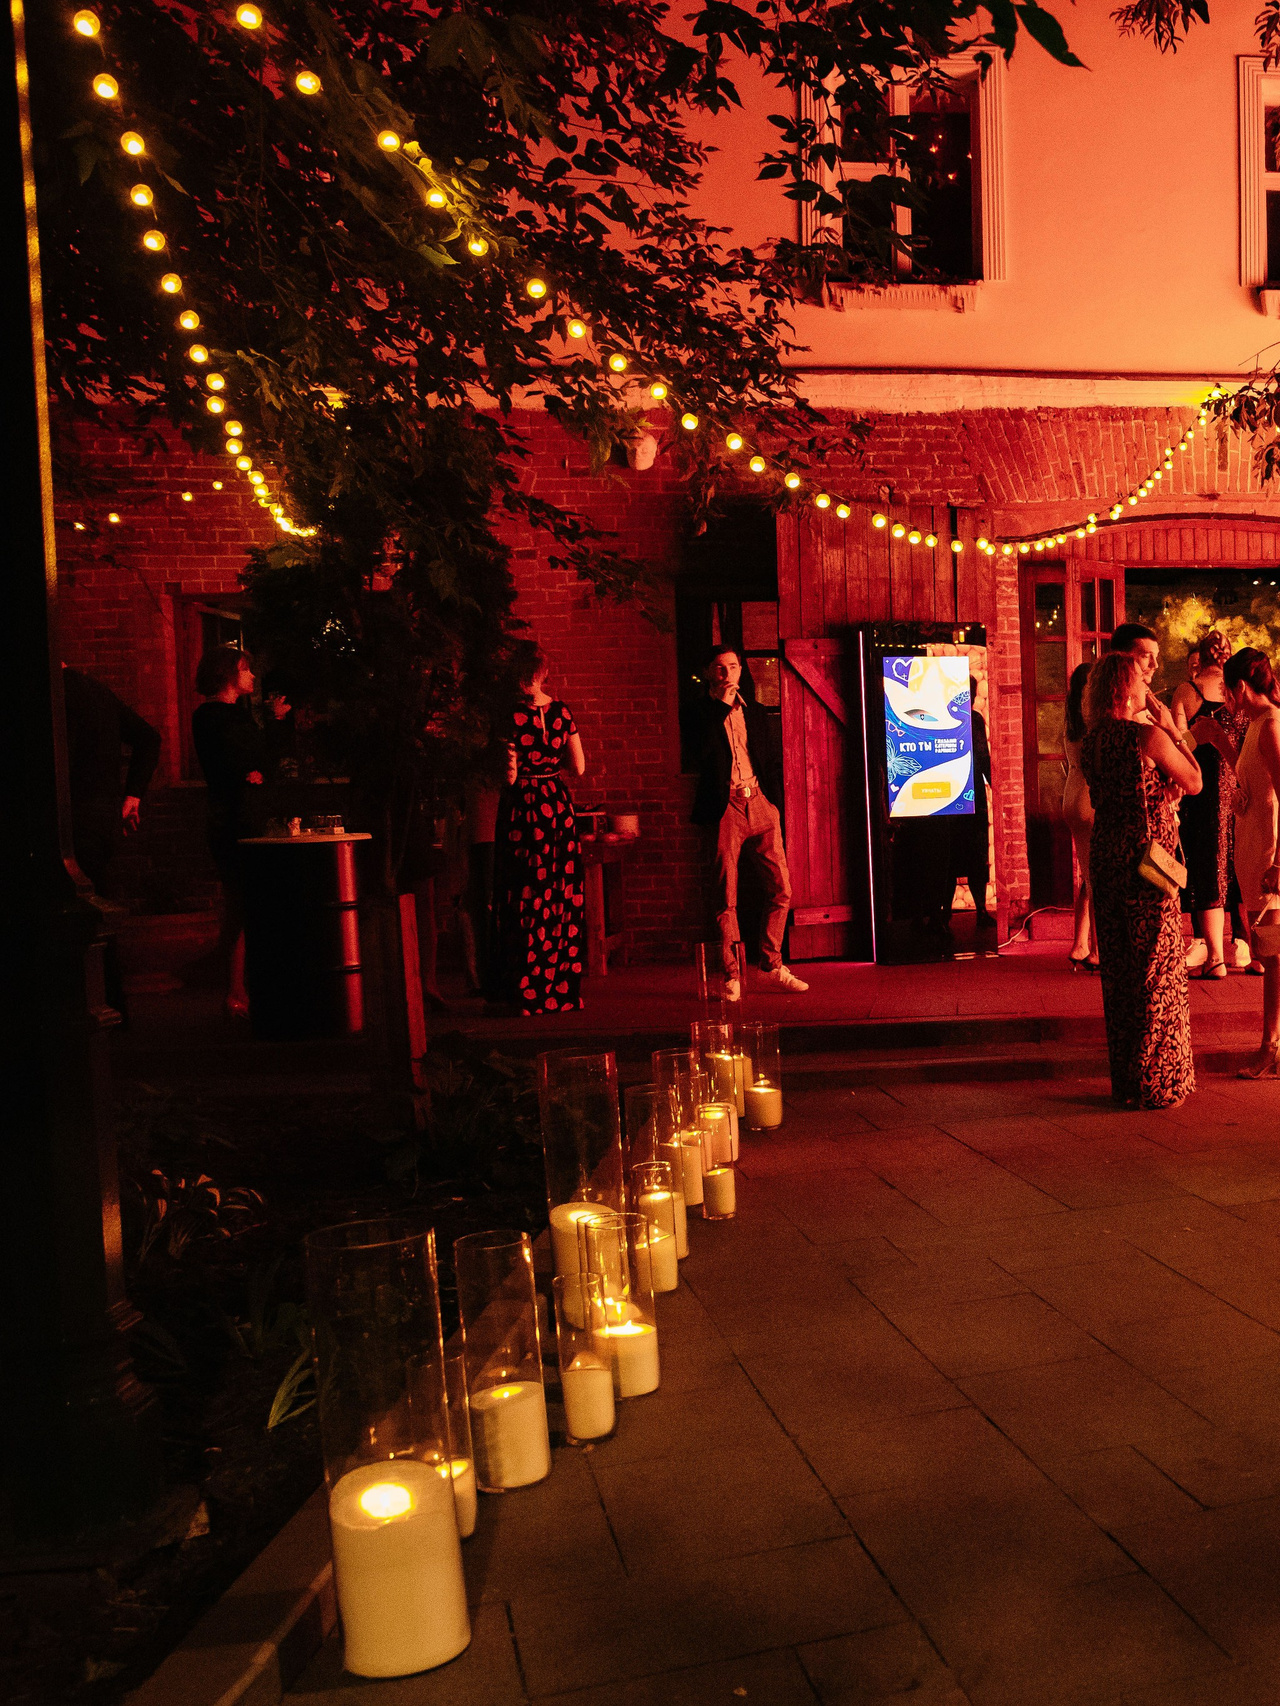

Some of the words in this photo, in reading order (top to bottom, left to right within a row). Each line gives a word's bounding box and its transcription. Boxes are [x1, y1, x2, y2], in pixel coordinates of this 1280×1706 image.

[899, 742, 917, 752] КТО
[918, 741, 932, 752] ТЫ
[959, 739, 965, 751] ?
